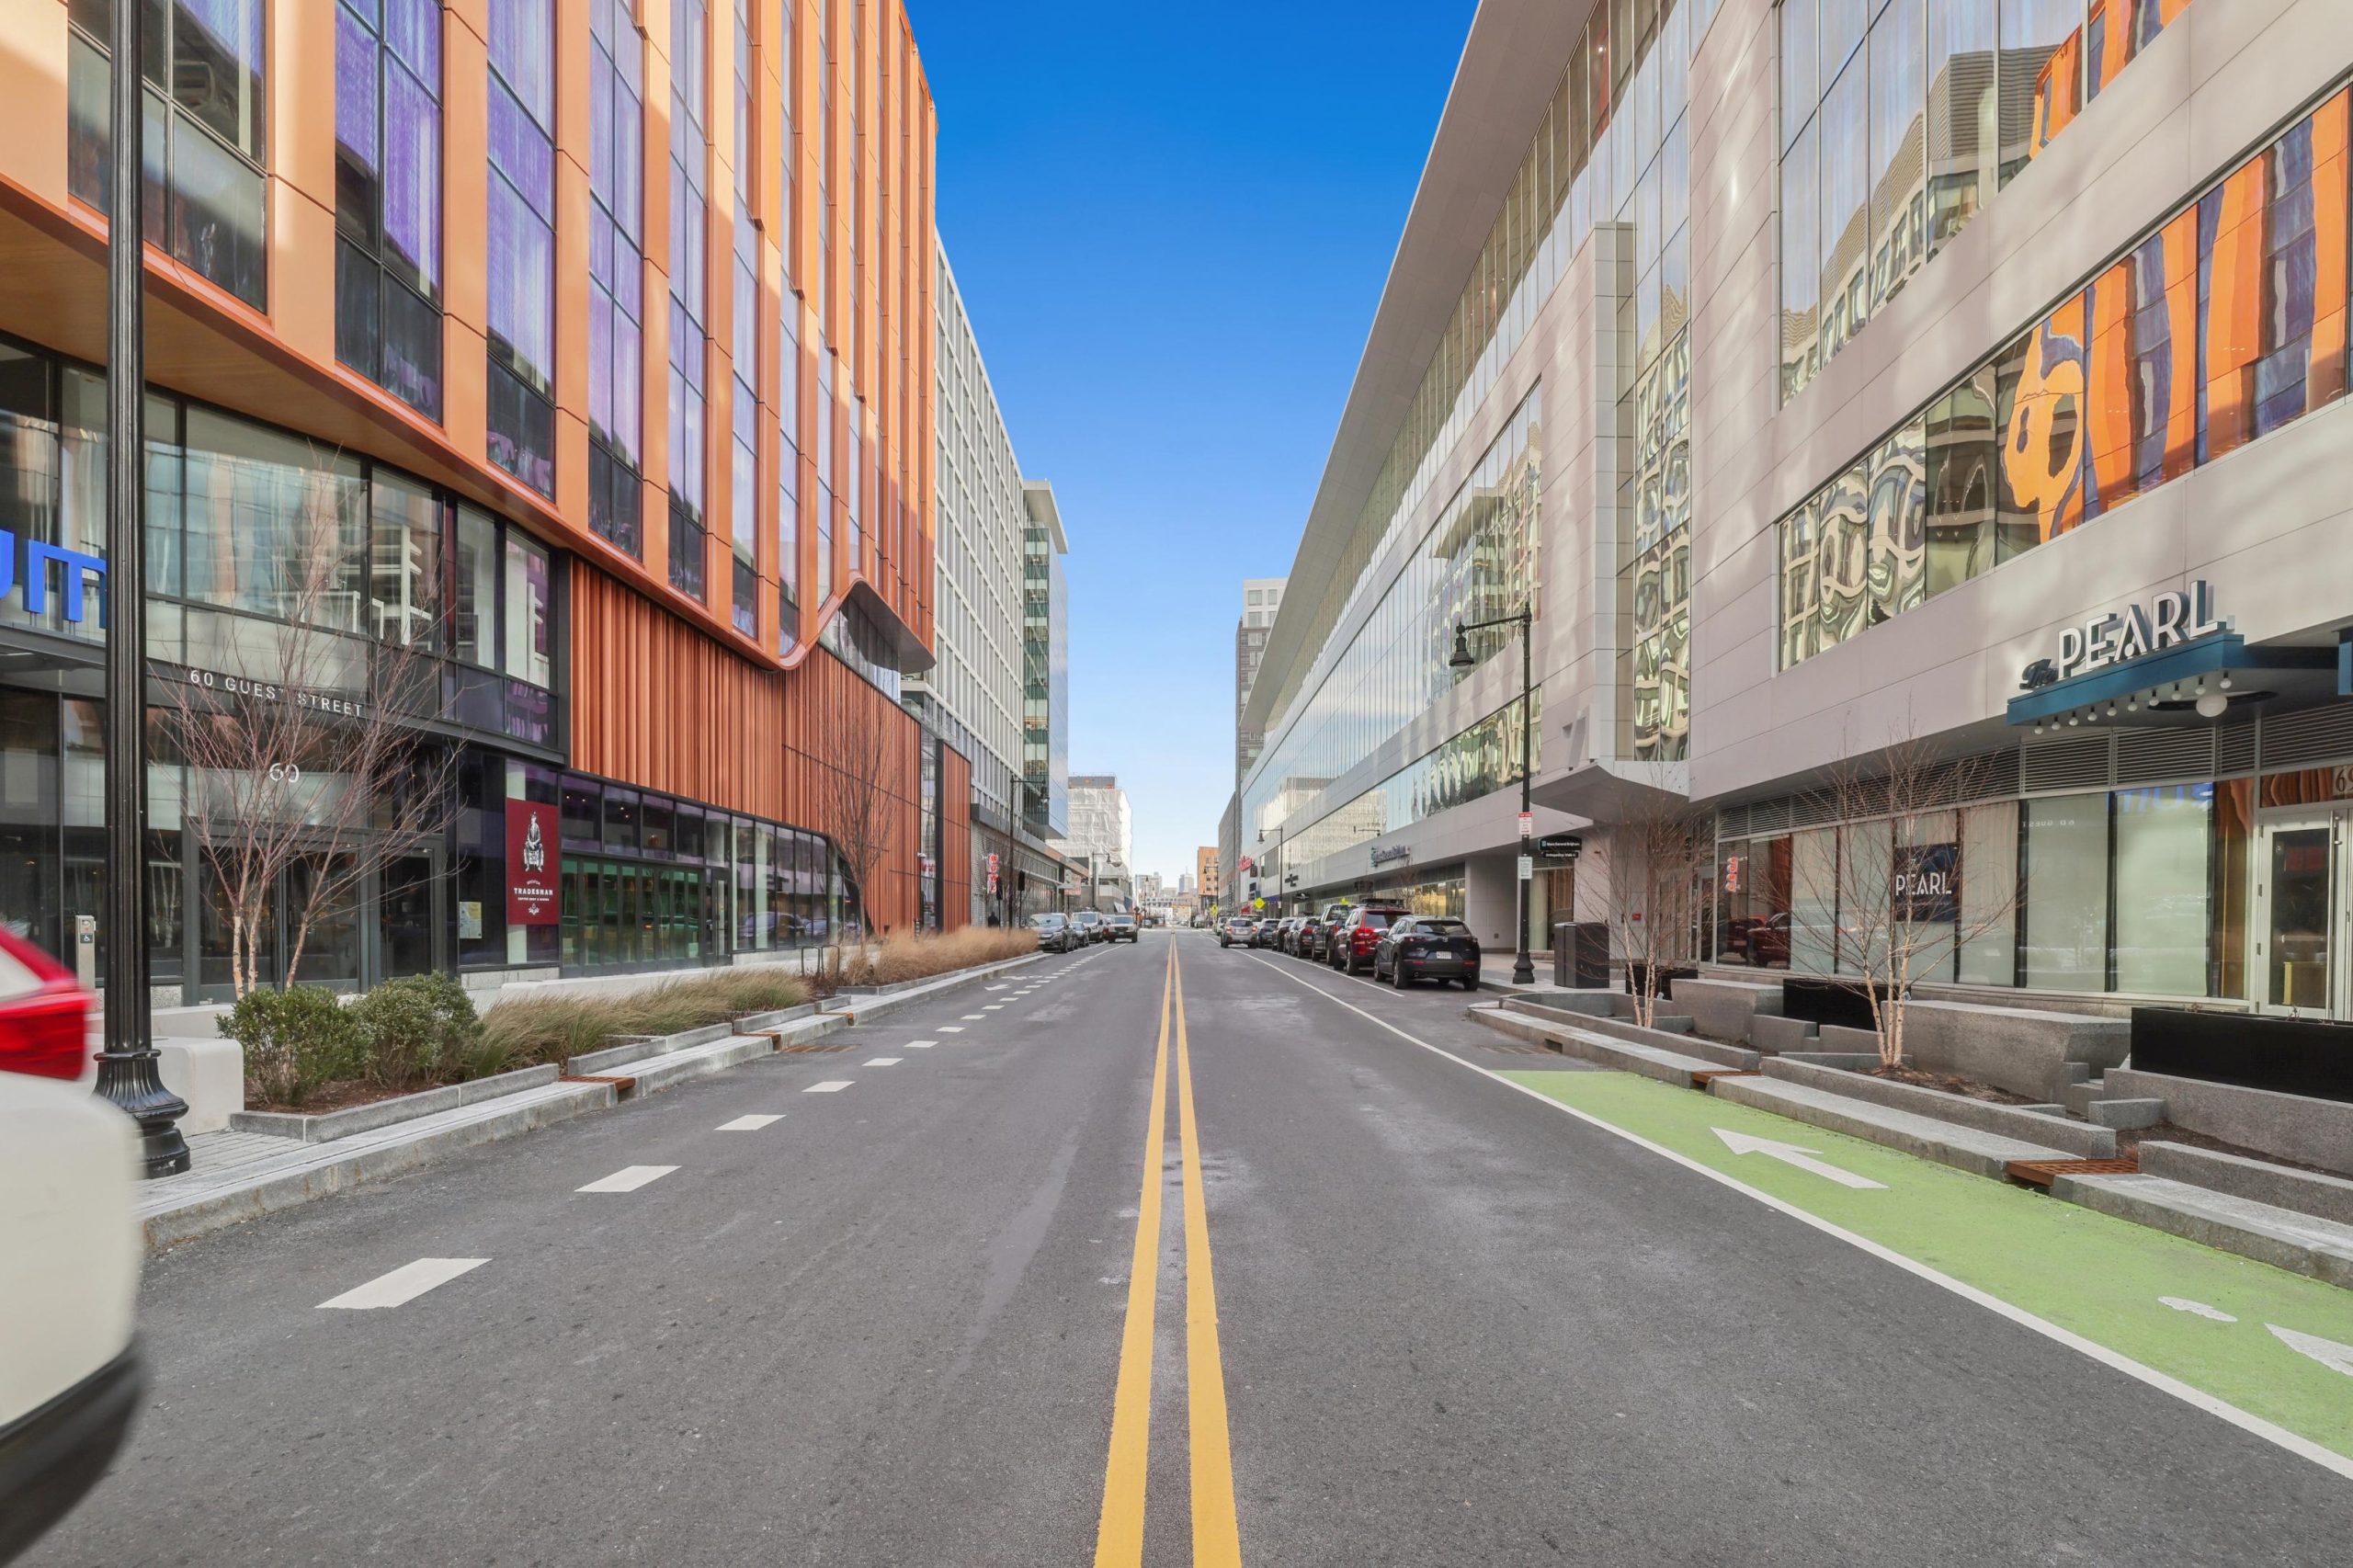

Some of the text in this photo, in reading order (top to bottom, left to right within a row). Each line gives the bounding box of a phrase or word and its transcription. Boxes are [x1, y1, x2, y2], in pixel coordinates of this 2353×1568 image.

[2058, 580, 2227, 680] PEARL
[190, 669, 213, 687] 60
[297, 691, 362, 716] STREET
[269, 762, 300, 782] 60
[514, 887, 553, 895] TRADESMAN
[1895, 871, 1952, 896] PEARL
